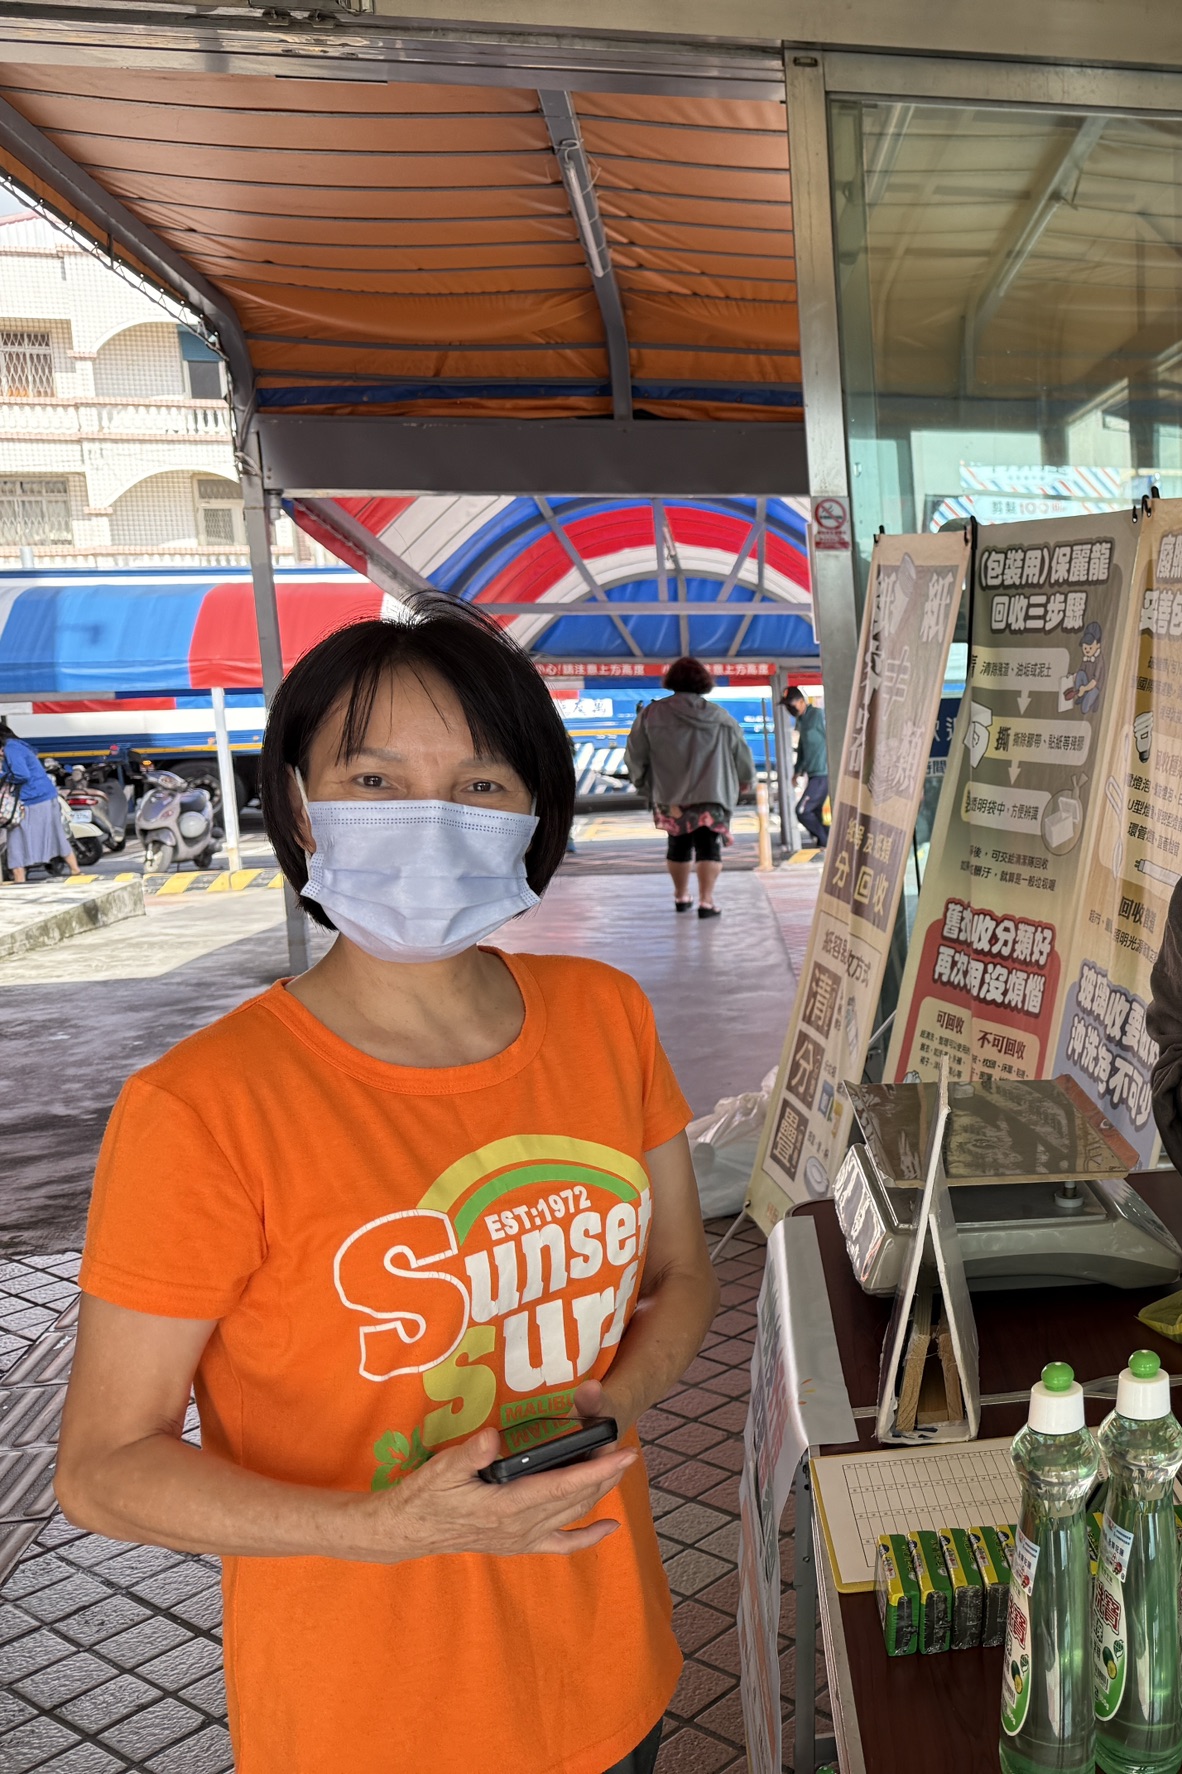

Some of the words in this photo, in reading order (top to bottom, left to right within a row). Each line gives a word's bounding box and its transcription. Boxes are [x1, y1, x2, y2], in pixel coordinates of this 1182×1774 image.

[980, 542, 1112, 587] (包裝用)保麗龍
[991, 592, 1088, 631] 回收三步驟
[936, 1010, 965, 1035] 可回收
[977, 1029, 1027, 1061] 不可回收
[484, 1185, 592, 1240] EST:1972
